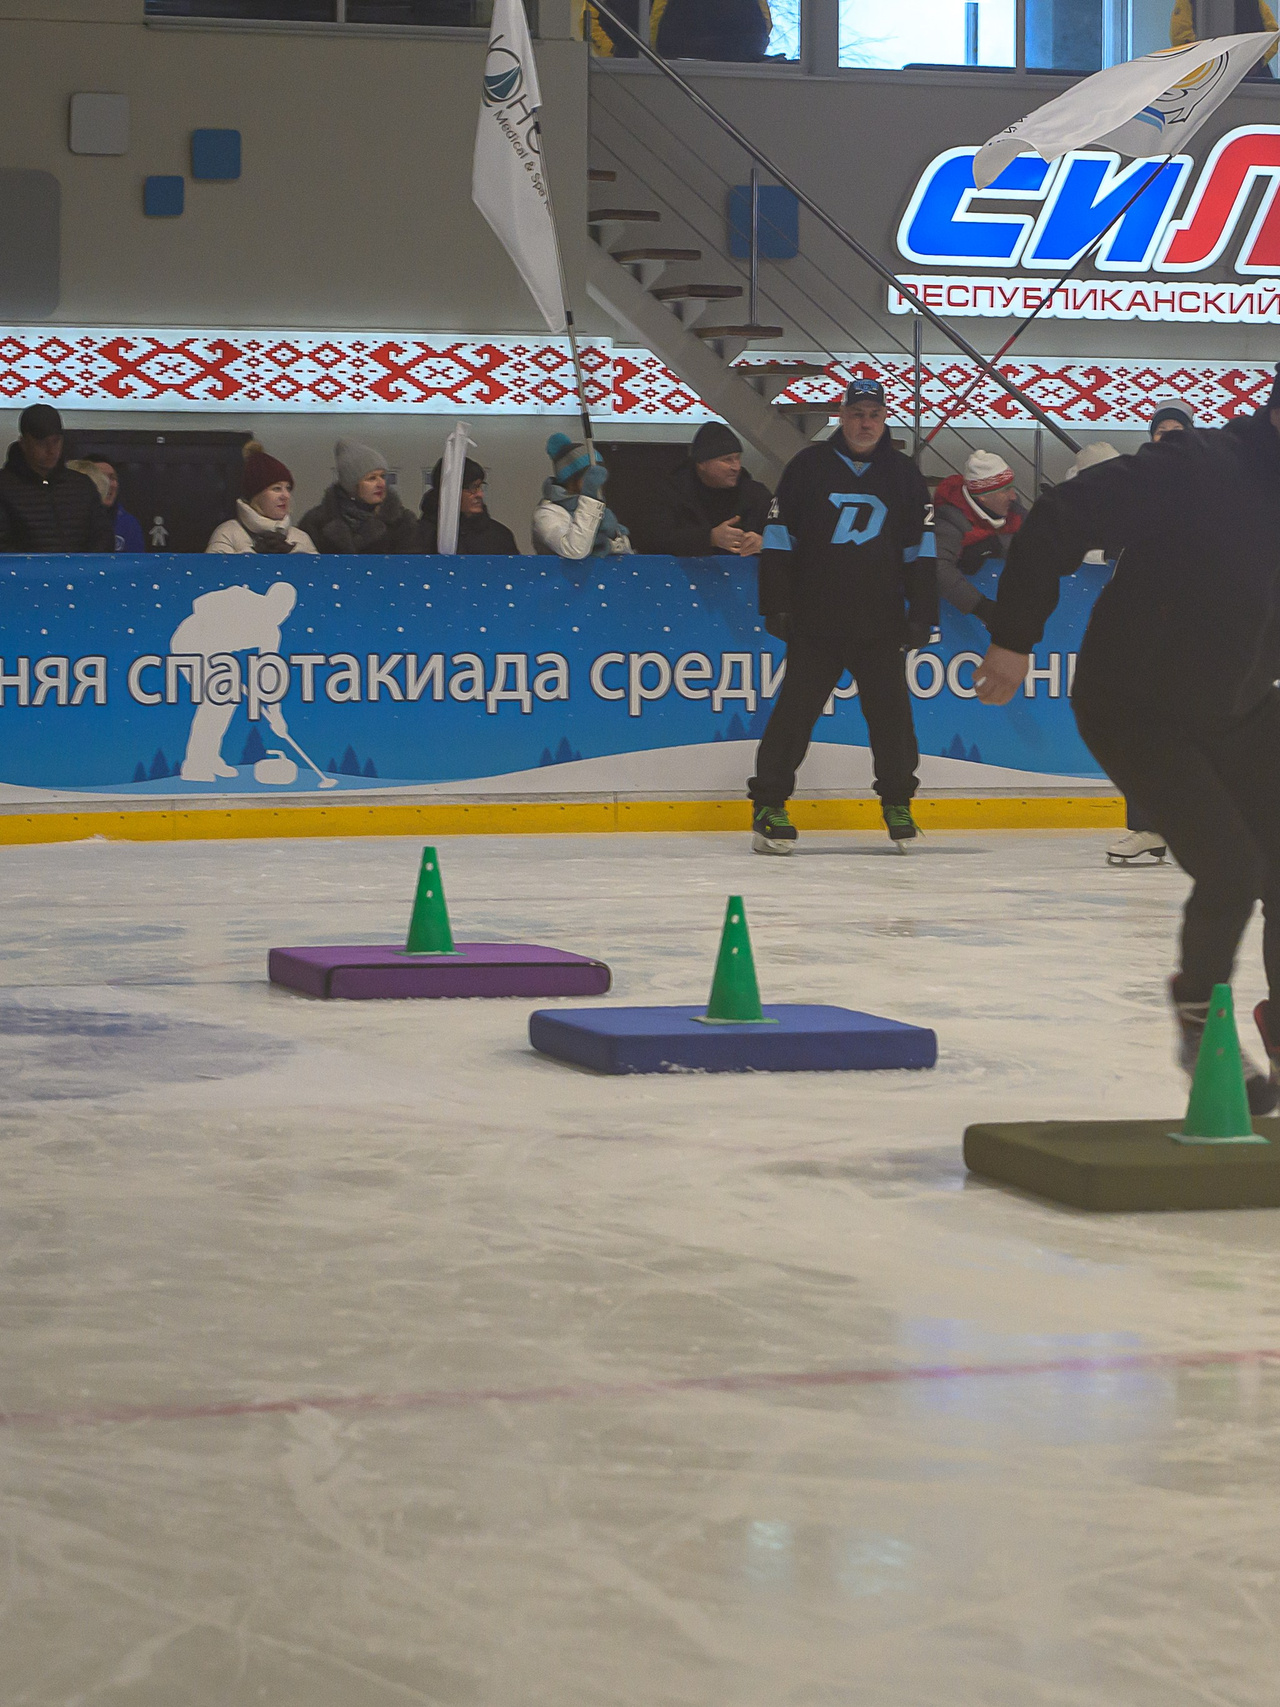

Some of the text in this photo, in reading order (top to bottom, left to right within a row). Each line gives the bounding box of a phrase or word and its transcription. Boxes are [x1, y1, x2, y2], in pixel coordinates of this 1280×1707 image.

[493, 109, 547, 198] Medical & Spa
[127, 652, 570, 721] спартакиада
